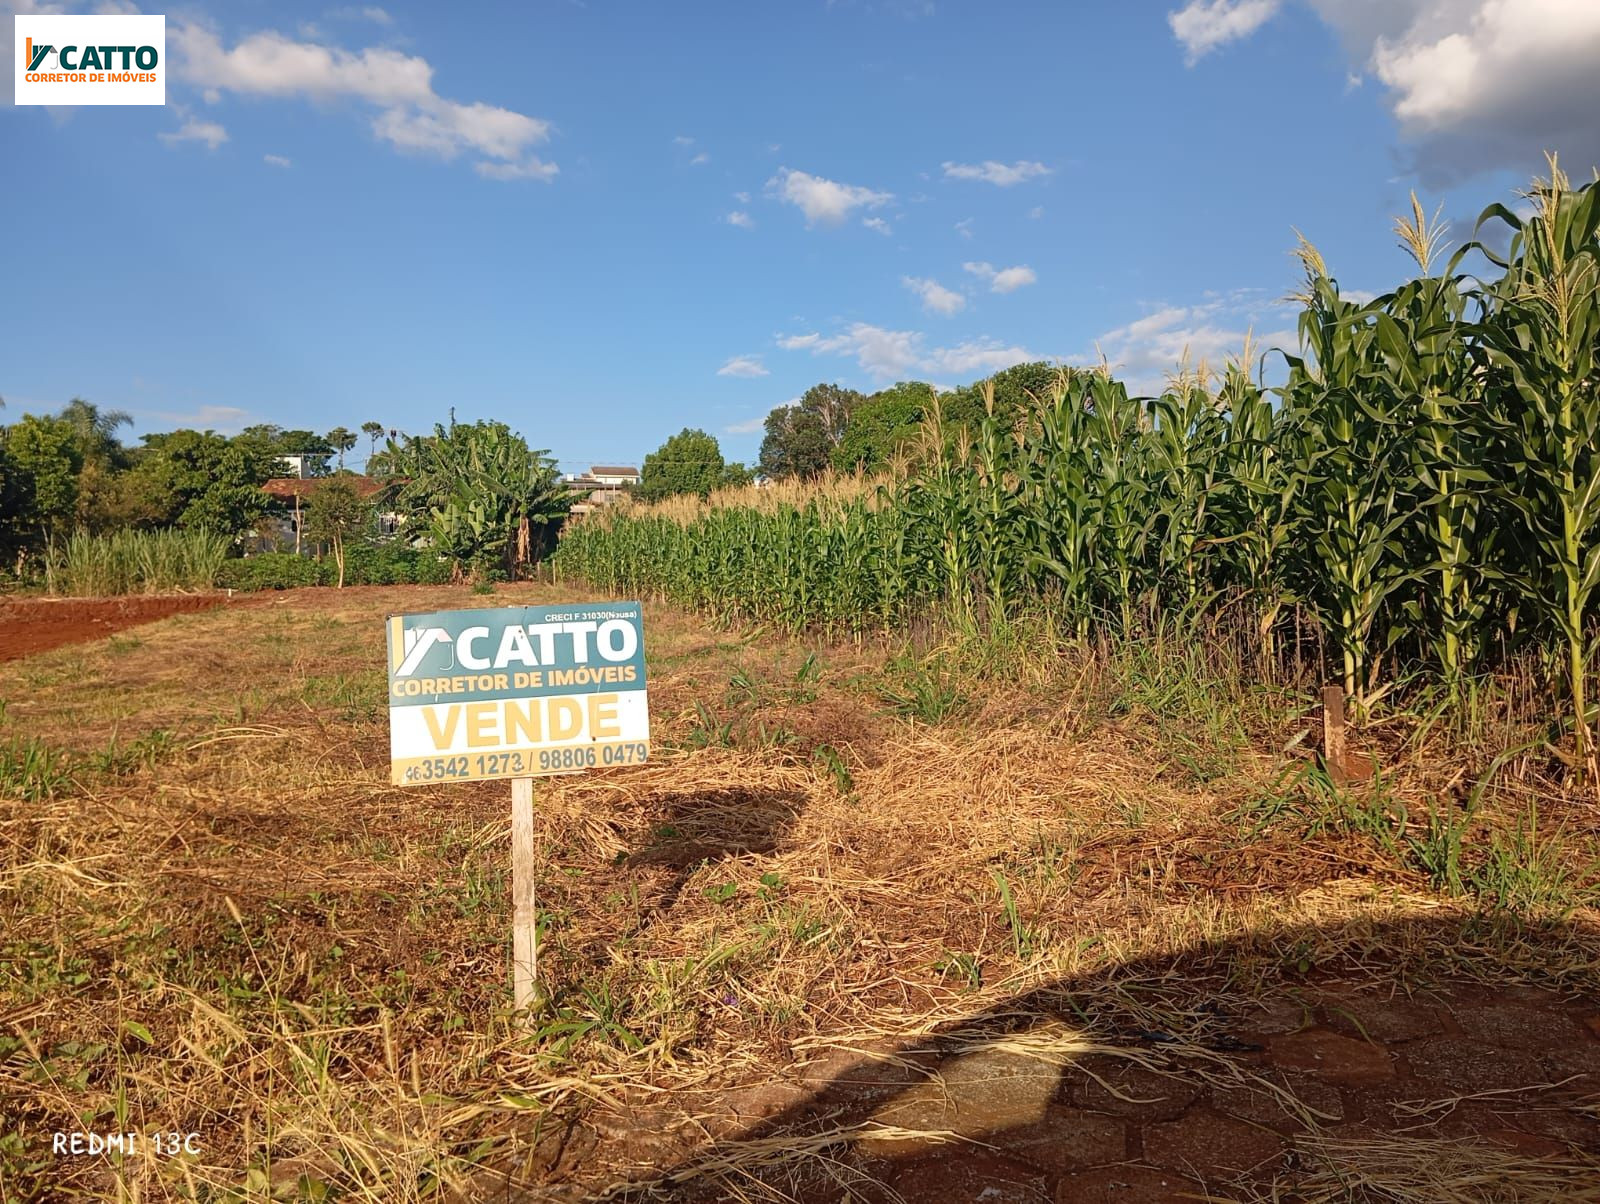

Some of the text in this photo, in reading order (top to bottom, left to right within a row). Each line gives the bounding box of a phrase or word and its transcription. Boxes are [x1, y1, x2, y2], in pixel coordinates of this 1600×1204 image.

[545, 613, 572, 622] CRECI
[574, 612, 580, 620] F
[456, 619, 638, 670] CATTO
[392, 665, 636, 697] CORRETOR DE IMÓVEIS
[421, 694, 621, 750] VENDE
[476, 752, 524, 775] 1273
[539, 747, 596, 770] 98806
[602, 743, 647, 764] 0479
